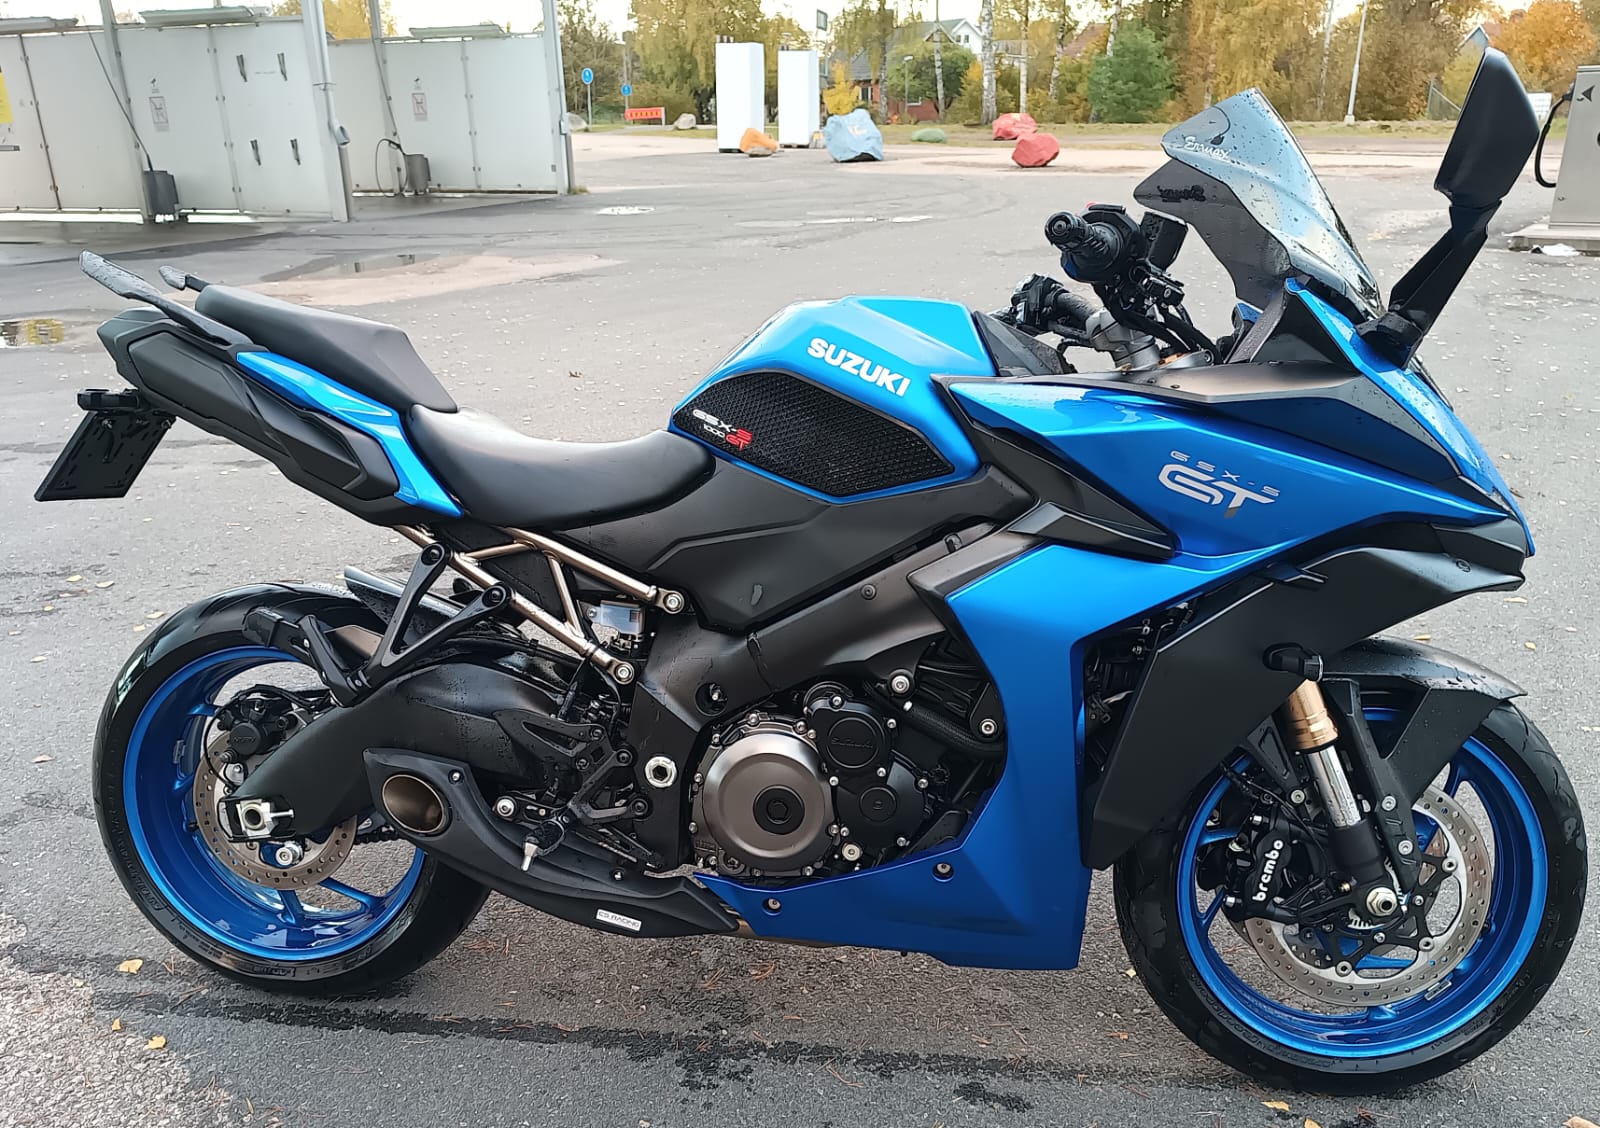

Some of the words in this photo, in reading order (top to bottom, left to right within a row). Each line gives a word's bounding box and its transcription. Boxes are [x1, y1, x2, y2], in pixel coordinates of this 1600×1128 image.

[807, 337, 912, 398] SUZUKI
[692, 408, 753, 443] GSX-S
[703, 423, 726, 438] 1000
[1158, 463, 1276, 519] GT
[1169, 450, 1280, 498] GSX-S
[1252, 839, 1284, 901] brembo
